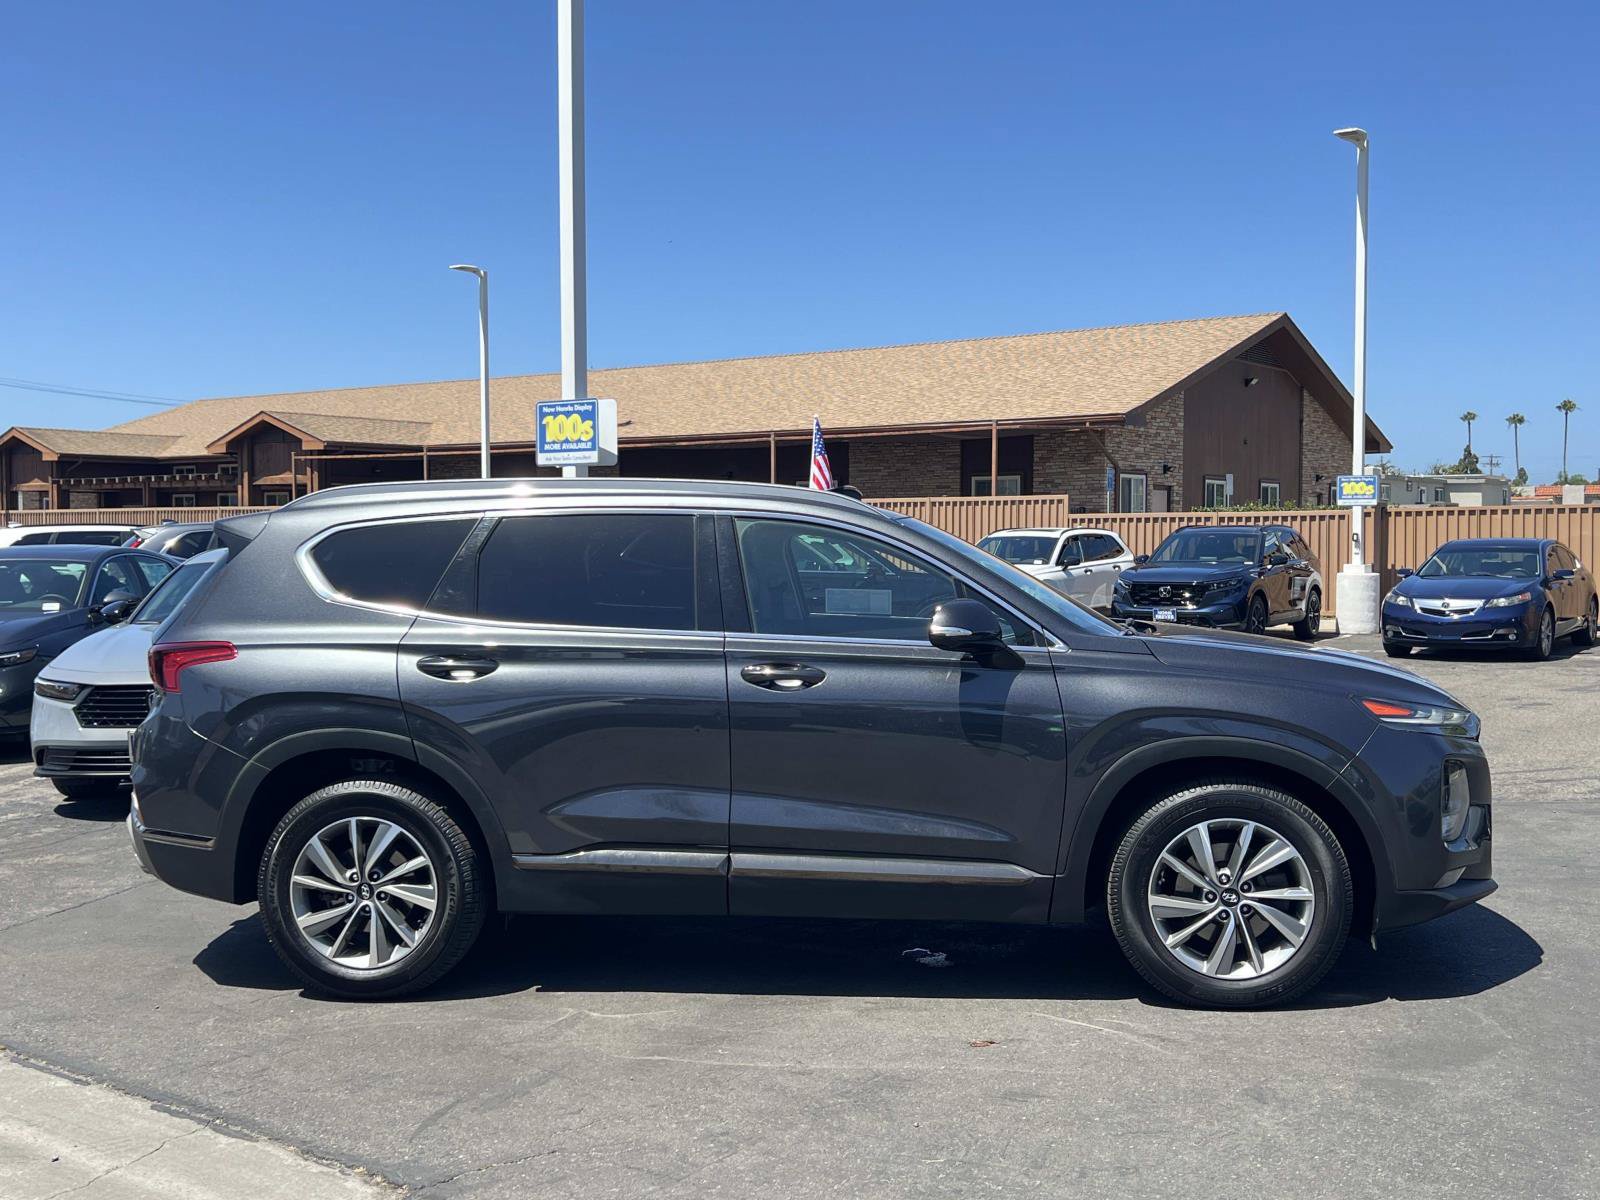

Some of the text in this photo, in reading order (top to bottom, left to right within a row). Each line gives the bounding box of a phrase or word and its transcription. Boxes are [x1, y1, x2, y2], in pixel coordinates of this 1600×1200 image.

[574, 404, 592, 412] Display
[542, 414, 593, 442] 100s
[1341, 481, 1374, 496] 100s
